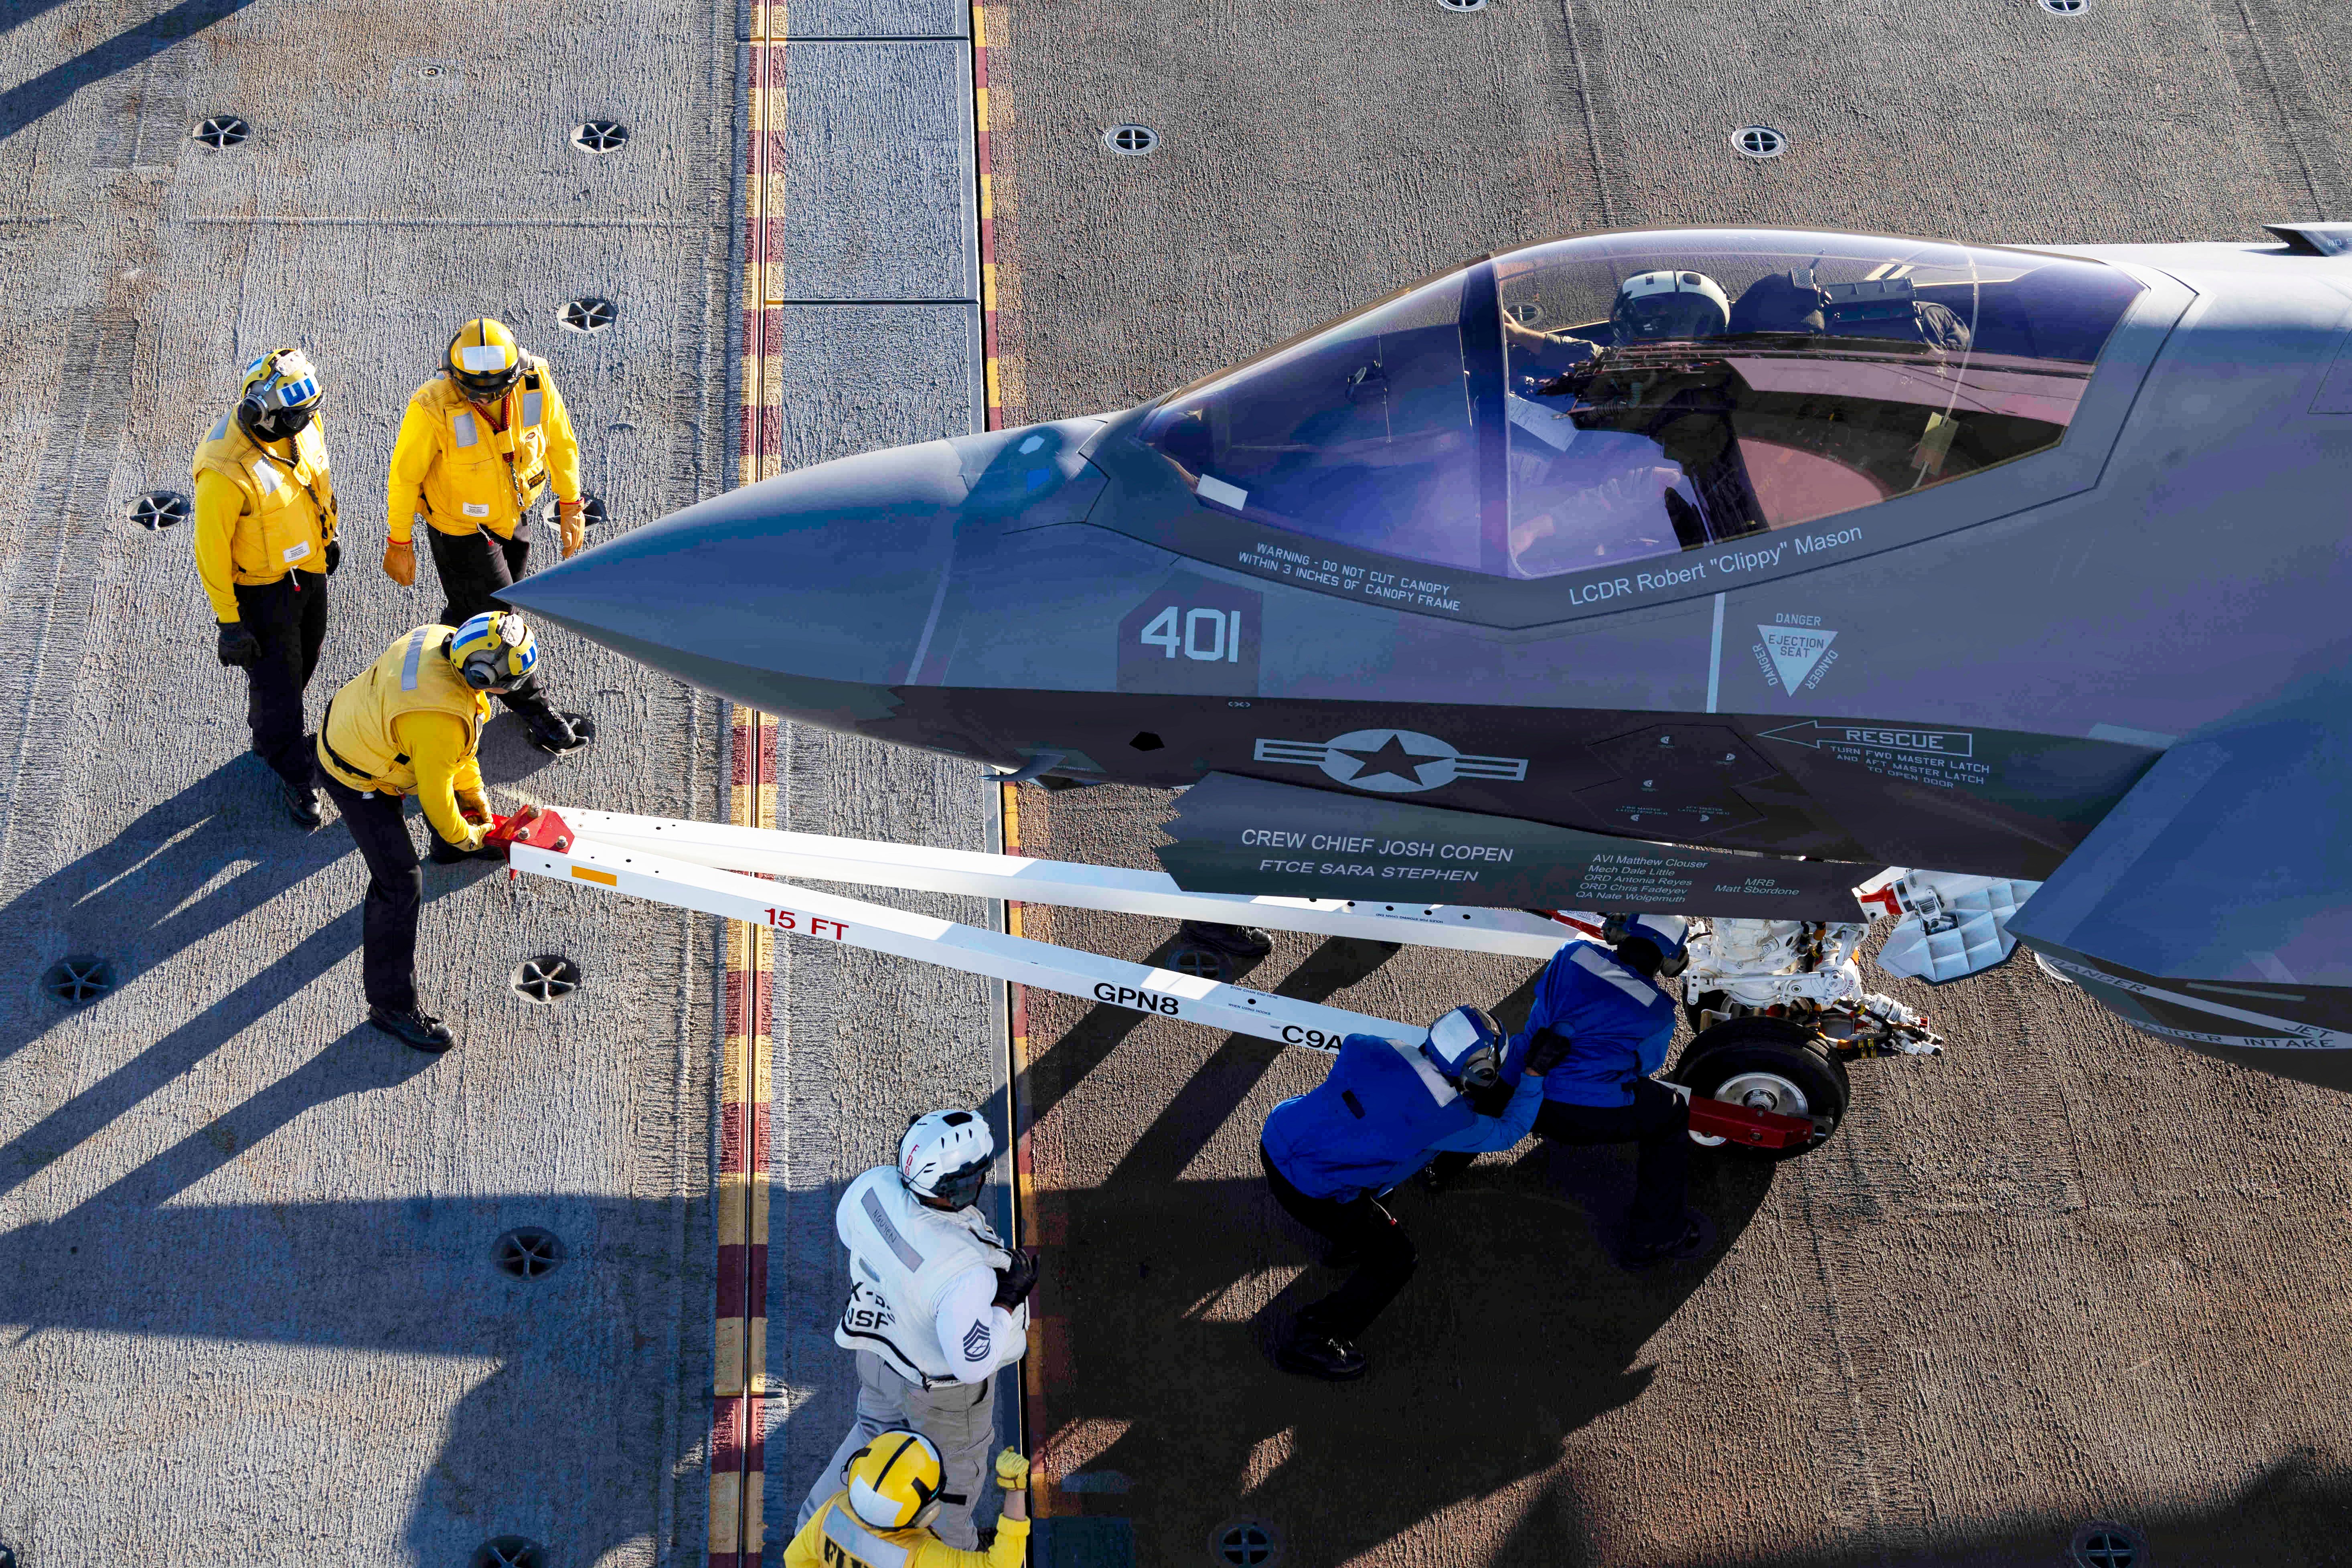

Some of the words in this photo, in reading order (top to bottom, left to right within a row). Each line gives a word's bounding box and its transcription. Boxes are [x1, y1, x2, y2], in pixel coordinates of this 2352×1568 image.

[1257, 543, 1310, 565] WARNING
[1323, 560, 1337, 572] DO
[1342, 565, 1365, 579] NOT
[1370, 571, 1395, 584] CUT
[1401, 578, 1450, 595] CANOPY
[1569, 578, 1632, 605] LCDR
[1637, 562, 1706, 592] Robert
[1710, 541, 1787, 573] "Clippy"
[1795, 527, 1862, 555] Mason
[1239, 552, 1278, 571] WITHIN
[1284, 565, 1290, 574] 3
[1296, 567, 1339, 586] INCHES
[1344, 580, 1359, 590] OF
[1365, 584, 1414, 602] CANOPY
[1418, 595, 1461, 611] FRAME
[1776, 613, 1821, 626] DANGER
[1141, 606, 1240, 662] 401
[1769, 634, 1824, 648] EJECTION
[1781, 646, 1810, 658] SEAT
[1752, 643, 1778, 686] DANGER
[1805, 650, 1838, 690] DANGER
[1846, 730, 1944, 749] RESCUE
[1829, 746, 1860, 754] TURN
[1866, 750, 1892, 759] FWD
[1897, 754, 1944, 767] MASTER
[1951, 761, 1989, 774] LATCH
[1866, 758, 1886, 767] AFT
[1892, 763, 1939, 776] MASTER
[1945, 771, 1984, 784] LATCH
[1887, 770, 1918, 780] OPEN
[1924, 777, 1953, 789] DOOR
[1242, 829, 1307, 849] CREW
[1311, 835, 1375, 853] CHIEF
[1379, 841, 1434, 857] JOSH
[1440, 844, 1514, 862] COPEN
[1260, 860, 1315, 873] FTCE
[1320, 863, 1376, 876] SARA
[1381, 867, 1479, 881] STEPHEN
[1592, 854, 1614, 863] AVI
[1617, 856, 1663, 866] Matthew
[1666, 859, 1708, 868] Clouser
[1621, 867, 1646, 875] Dale
[1610, 883, 1638, 891] Chris
[1641, 886, 1688, 895] Fadeyev
[1614, 875, 1655, 884] Antonia
[1658, 878, 1693, 886] Reyes
[1744, 886, 1799, 895] Sbordone
[1626, 894, 1685, 902] Wolgemuth
[764, 908, 796, 929] 15
[811, 917, 849, 940] FT
[2049, 958, 2147, 992] DANGER
[1839, 980, 1854, 996] CAUTION
[1094, 983, 1179, 1015] GPN8
[2284, 1025, 2334, 1038] JET
[2244, 1038, 2336, 1047] INTAKE
[872, 1209, 897, 1243] NGUYEN
